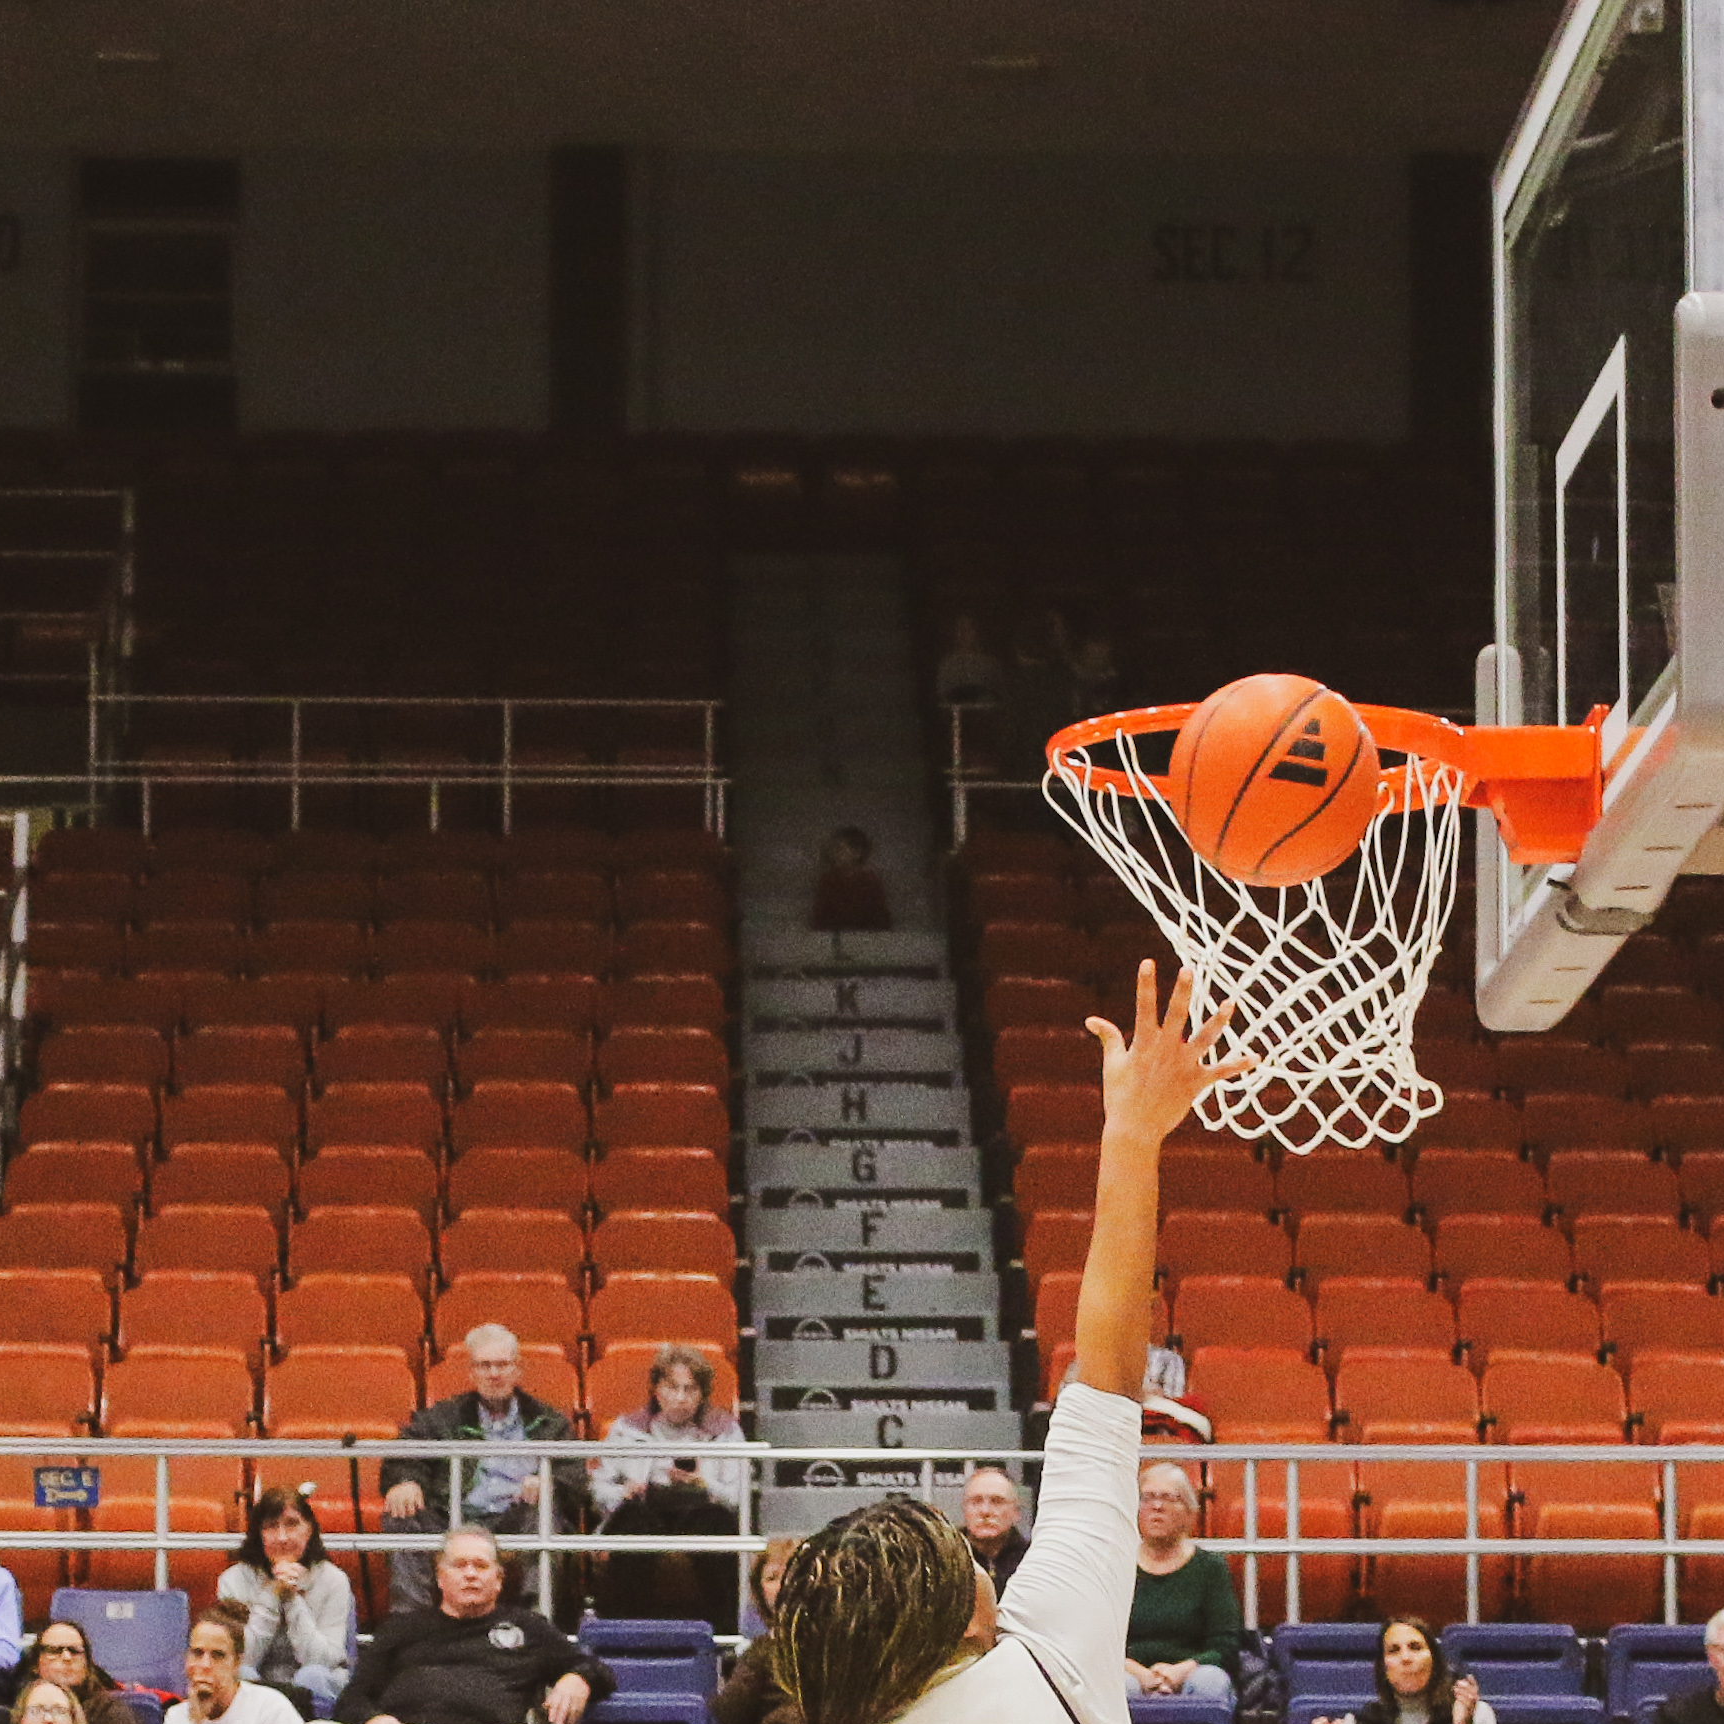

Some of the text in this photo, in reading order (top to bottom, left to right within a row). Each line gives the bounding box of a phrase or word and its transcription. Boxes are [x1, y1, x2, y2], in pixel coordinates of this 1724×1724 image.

[863, 1274, 887, 1312] E
[868, 1343, 899, 1380] D
[878, 1415, 904, 1449] C
